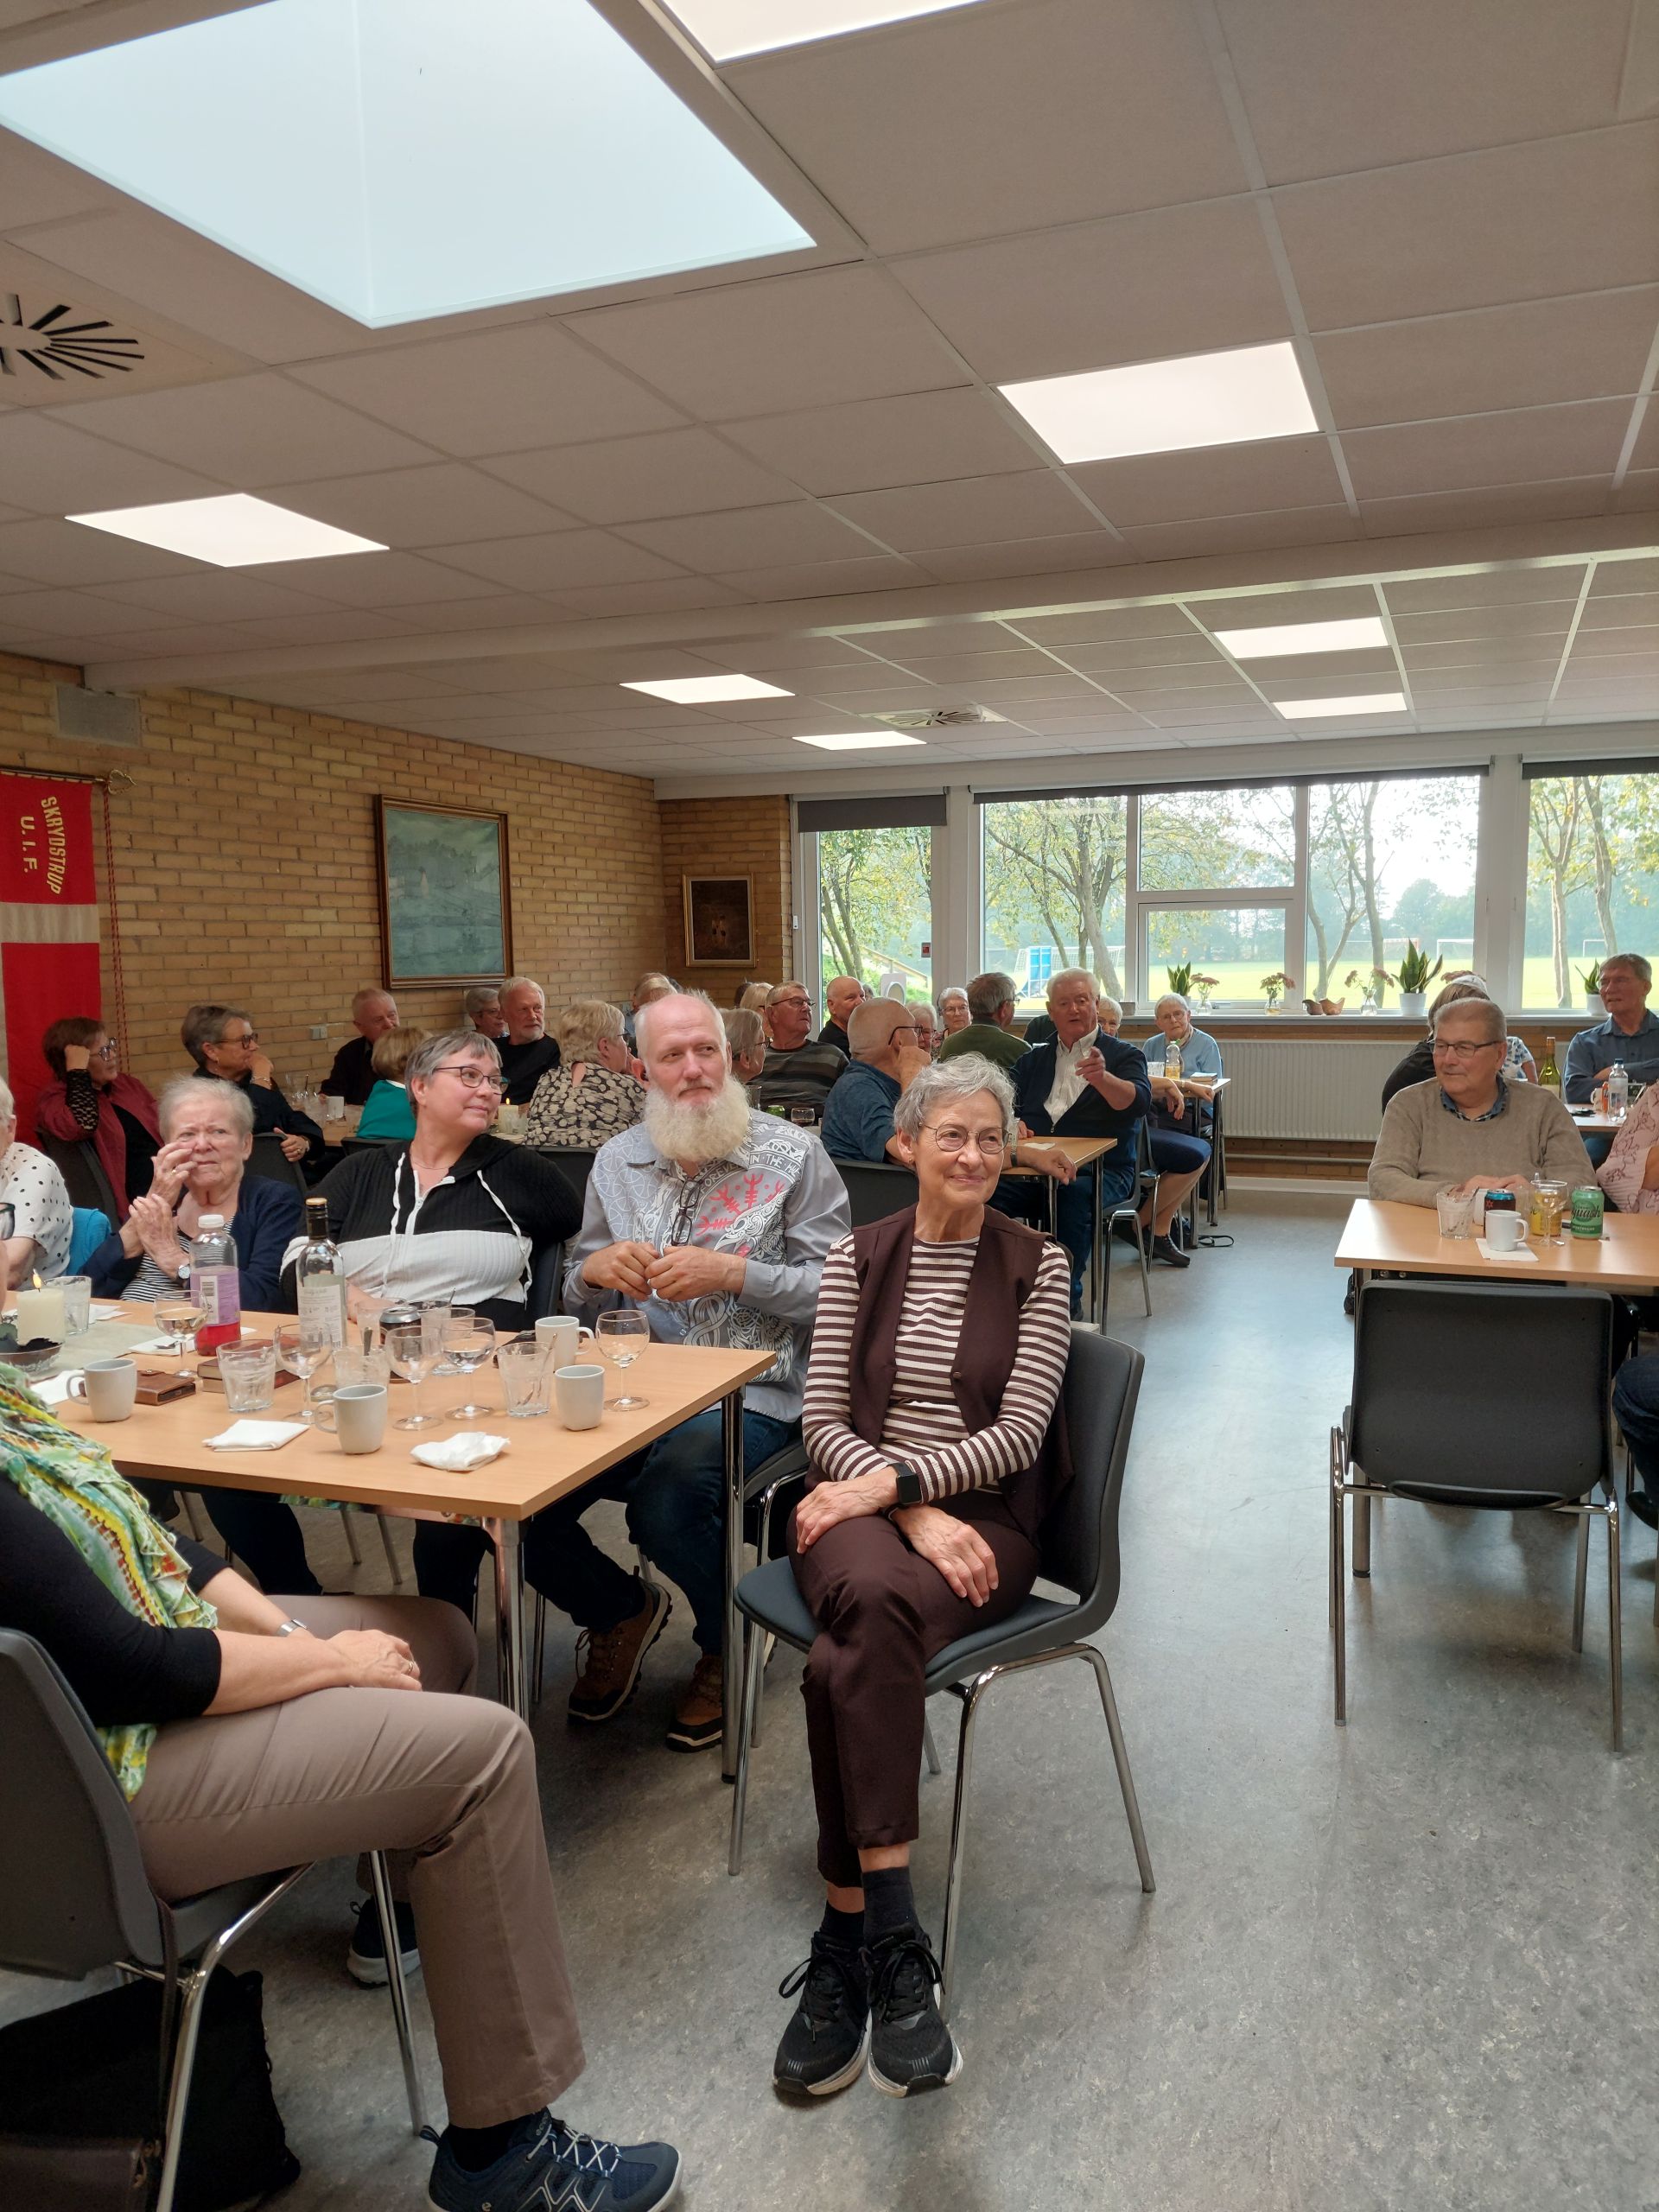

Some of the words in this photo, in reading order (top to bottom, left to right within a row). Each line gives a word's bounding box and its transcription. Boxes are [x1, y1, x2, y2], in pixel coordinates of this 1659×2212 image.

[41, 796, 67, 894] SKRYDSTRUP
[750, 1154, 760, 1165] IN
[766, 1154, 785, 1169] THE
